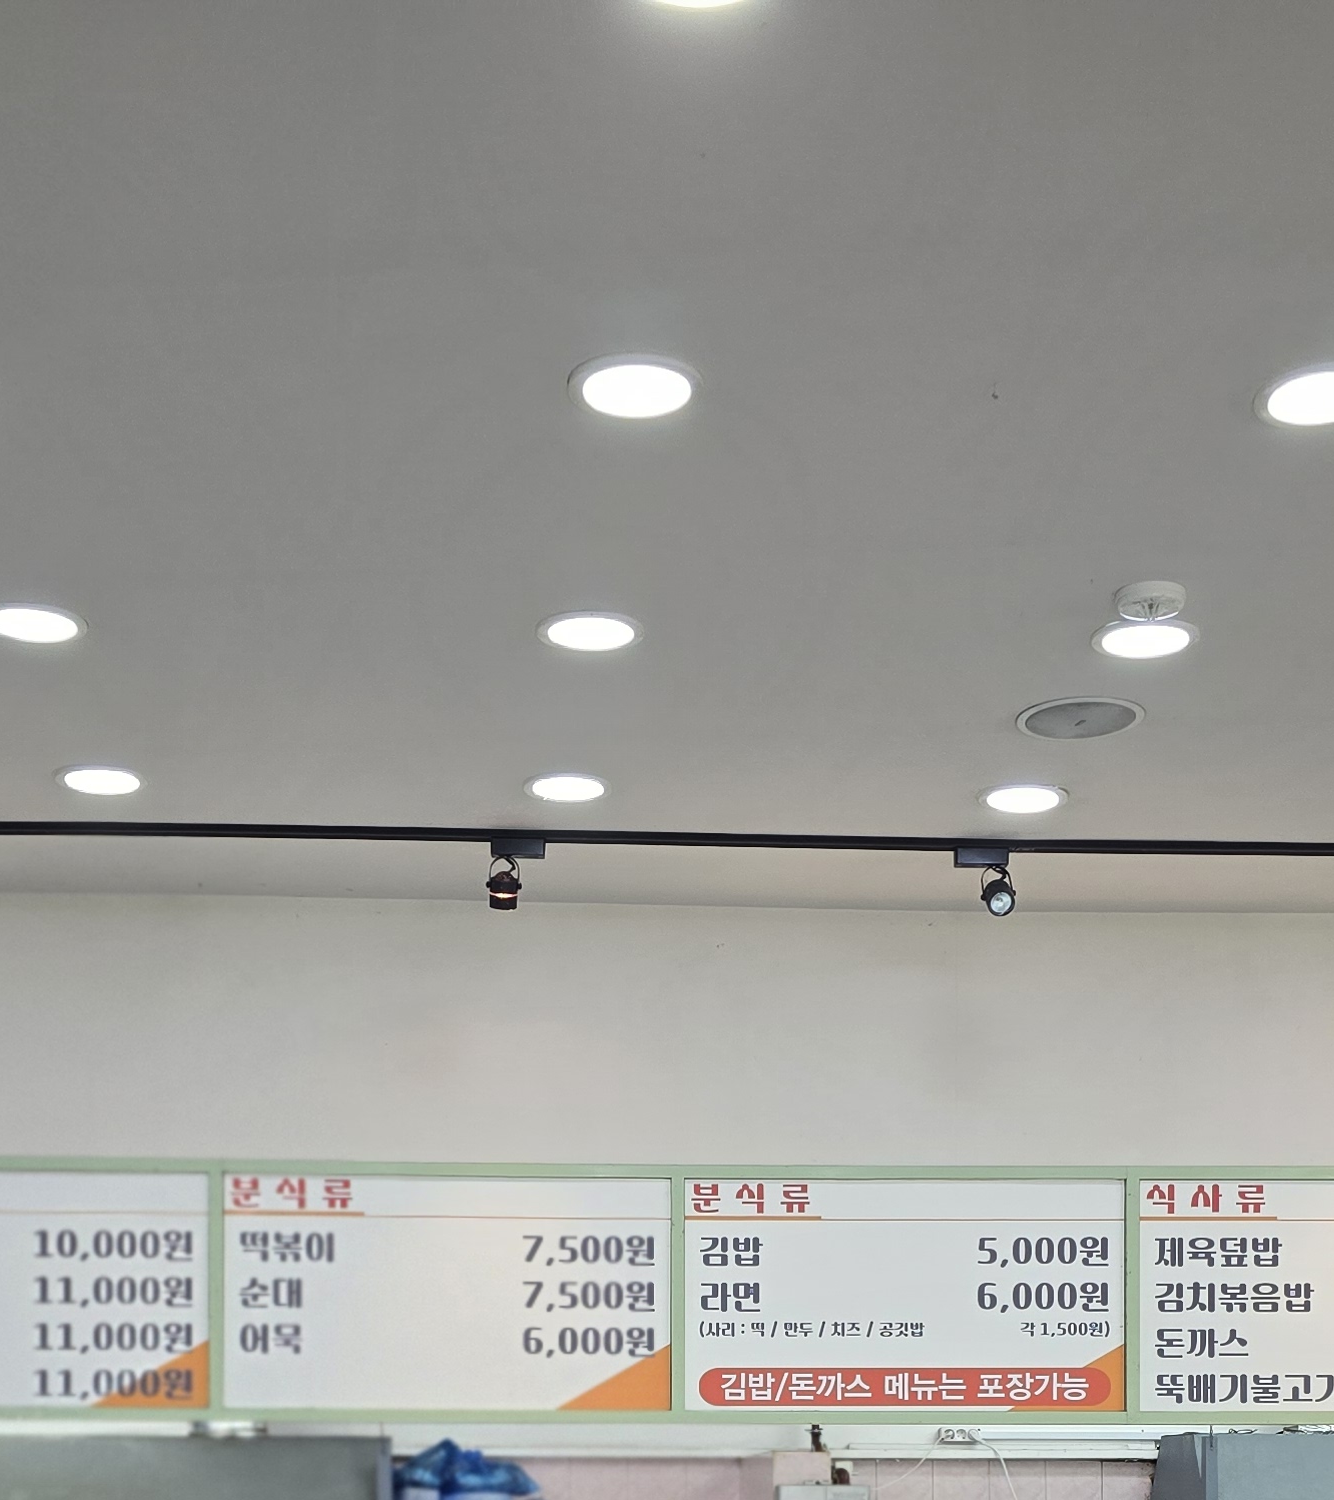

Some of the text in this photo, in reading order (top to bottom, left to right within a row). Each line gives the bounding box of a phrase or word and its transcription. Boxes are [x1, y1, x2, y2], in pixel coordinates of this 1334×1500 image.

[36, 1229, 193, 1262] 10,000원
[239, 1231, 655, 1267] 떡볶이 7,500원
[699, 1236, 1109, 1268] 김밥 5,000원
[1154, 1237, 1283, 1268] 제육덮밥
[36, 1275, 193, 1308] 11,000원
[240, 1277, 656, 1313] 순대 7,500원
[700, 1282, 1109, 1314] 라면 6,000원
[1154, 1281, 1315, 1313] 김치볶음밥
[37, 1322, 193, 1354] 11,000원
[239, 1323, 655, 1358] 어묵 6,000원
[751, 1322, 765, 1337] 떡
[784, 1322, 813, 1337] 만두
[831, 1322, 861, 1337] 치즈
[879, 1322, 925, 1337] 공깃밥
[1020, 1321, 1035, 1338] 각
[1154, 1328, 1249, 1359] 돈까스
[37, 1368, 194, 1400] 11,000원
[721, 1372, 1090, 1402] 김밥/돈까스 메뉴는 포장가능
